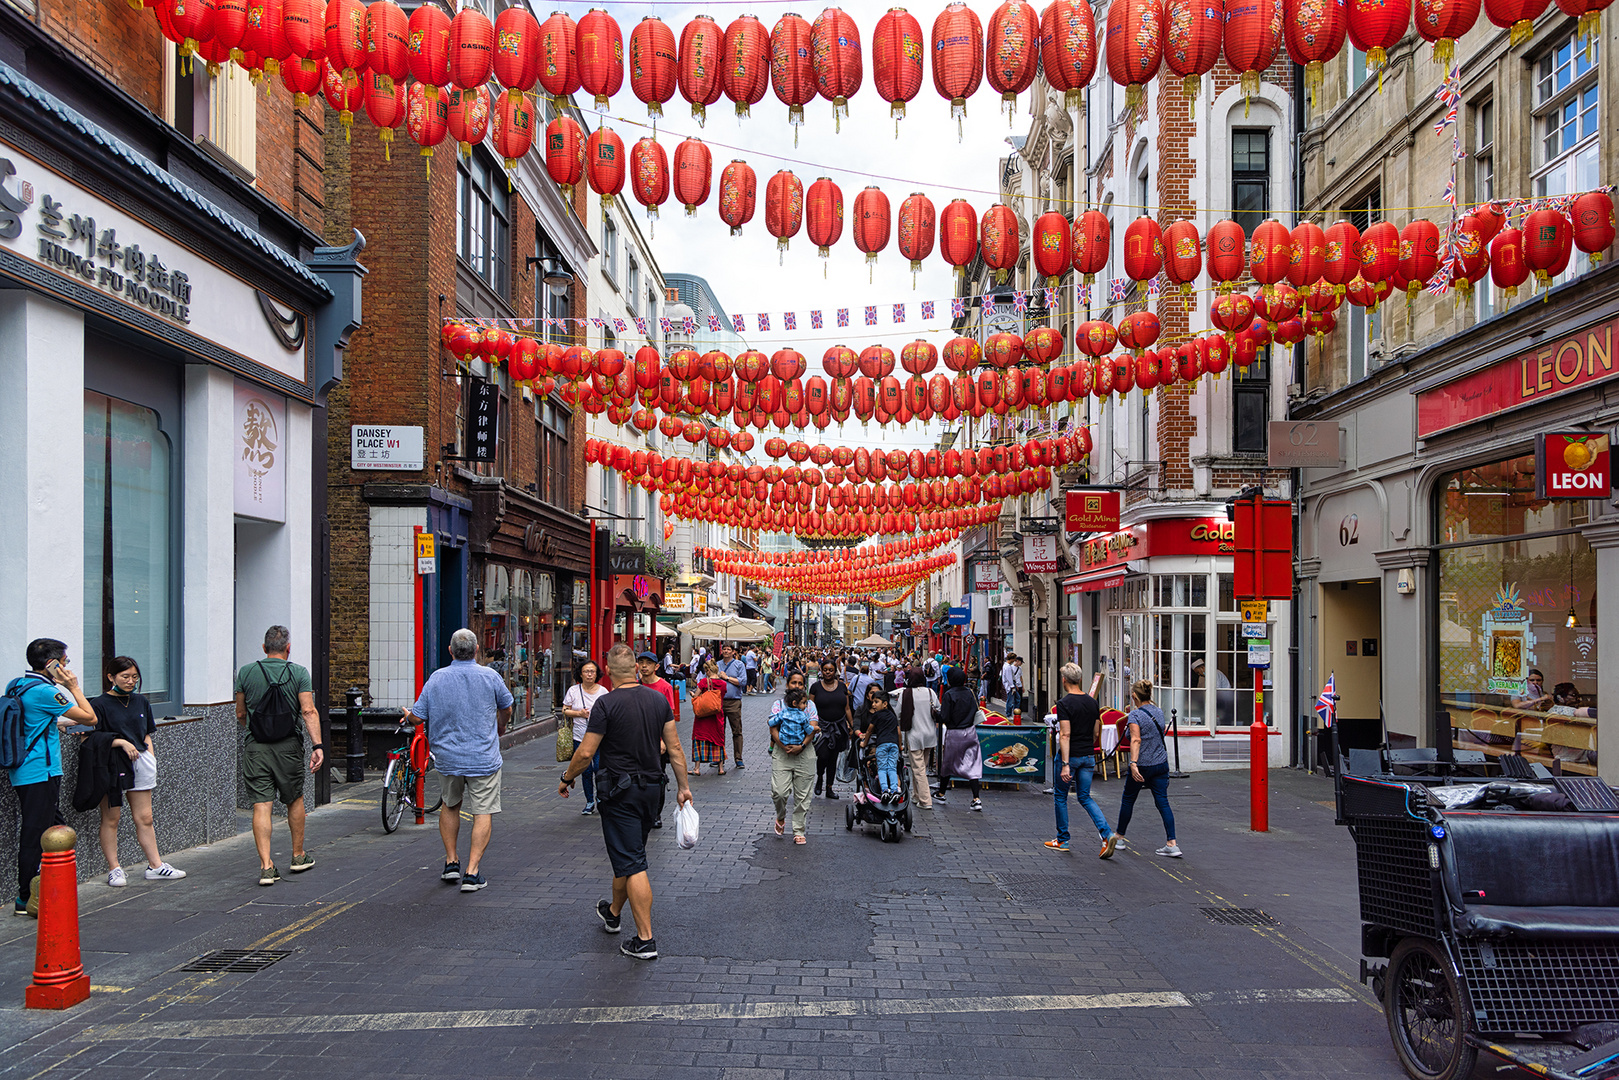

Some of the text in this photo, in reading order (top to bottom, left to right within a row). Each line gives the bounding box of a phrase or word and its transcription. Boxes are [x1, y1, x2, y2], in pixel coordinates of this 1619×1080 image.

[217, 4, 246, 13] CASINO
[461, 43, 491, 51] CASINO
[38, 238, 191, 325] KUNG FU NOODLE
[1521, 325, 1613, 399] LEON
[357, 429, 391, 437] DANSEY
[1289, 423, 1319, 446] 62
[357, 439, 400, 448] PLACE W1
[1552, 473, 1602, 489] LEON
[1190, 524, 1235, 540] Gold
[1339, 513, 1359, 546] 62
[611, 555, 640, 569] Viet
[1025, 563, 1045, 572] Wong
[1502, 602, 1513, 610] LEON
[1574, 636, 1585, 644] FREE
[54, 692, 69, 706] 8
